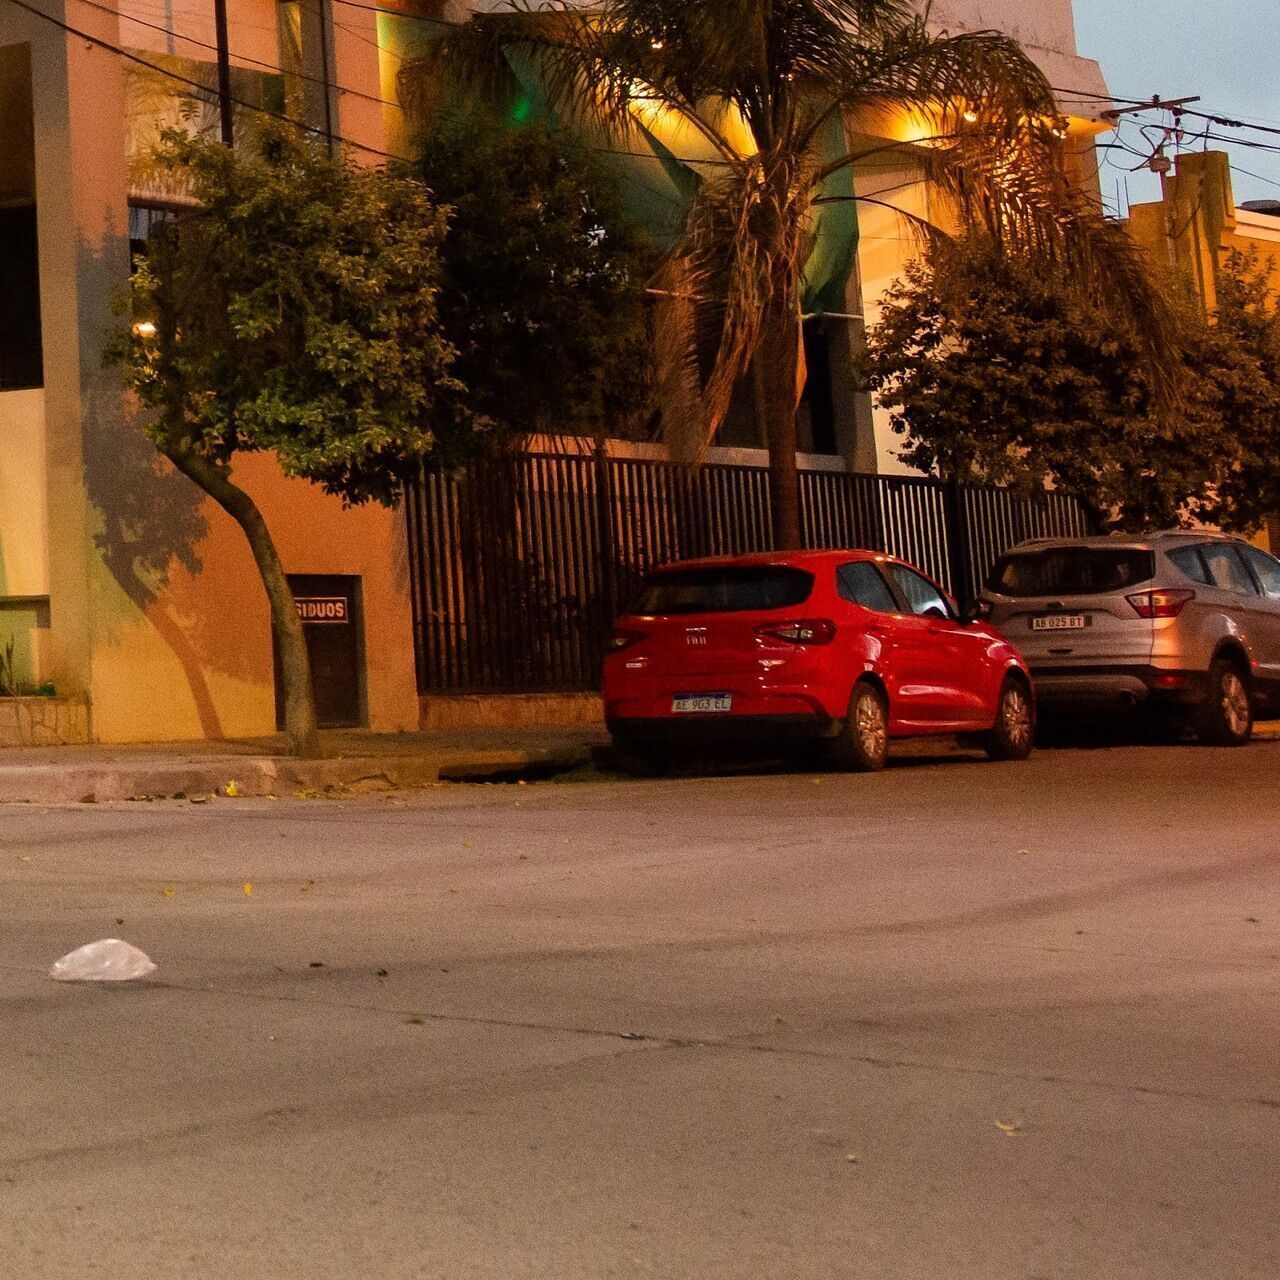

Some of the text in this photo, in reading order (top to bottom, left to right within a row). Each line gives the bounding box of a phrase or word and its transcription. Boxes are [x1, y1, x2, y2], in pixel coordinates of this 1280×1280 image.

[295, 602, 344, 618] SIDUOS
[1035, 617, 1082, 628] AB 025 BT
